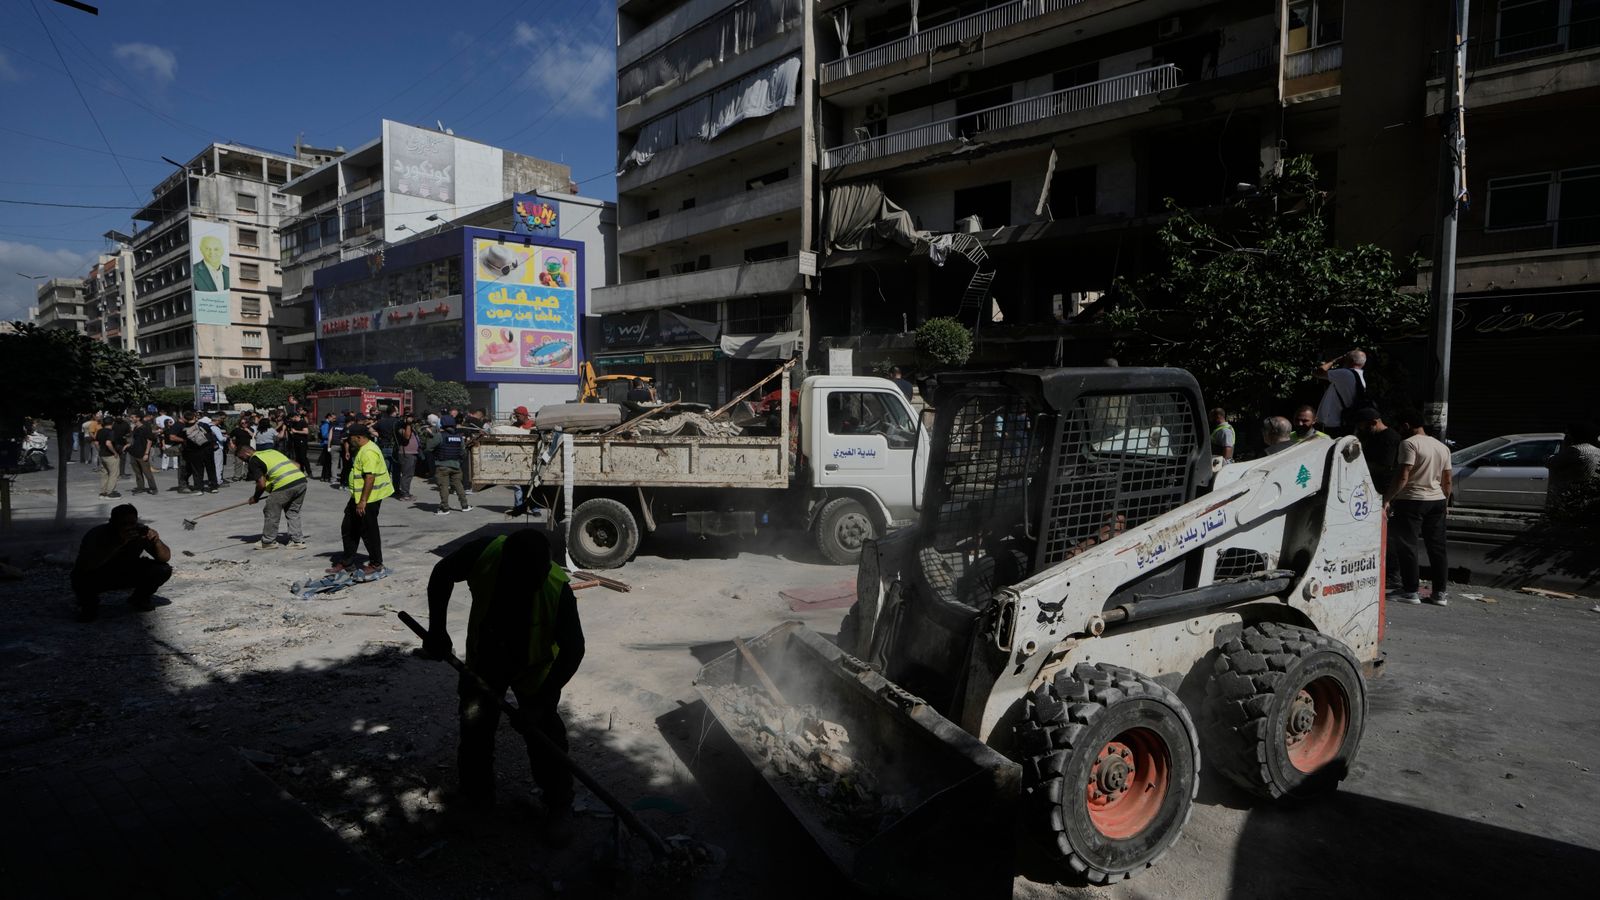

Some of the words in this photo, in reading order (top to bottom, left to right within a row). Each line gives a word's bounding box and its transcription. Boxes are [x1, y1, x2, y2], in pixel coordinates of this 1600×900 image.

[833, 447, 857, 459] الغبيري
[857, 447, 876, 458] بلدية
[1355, 501, 1368, 516] 25
